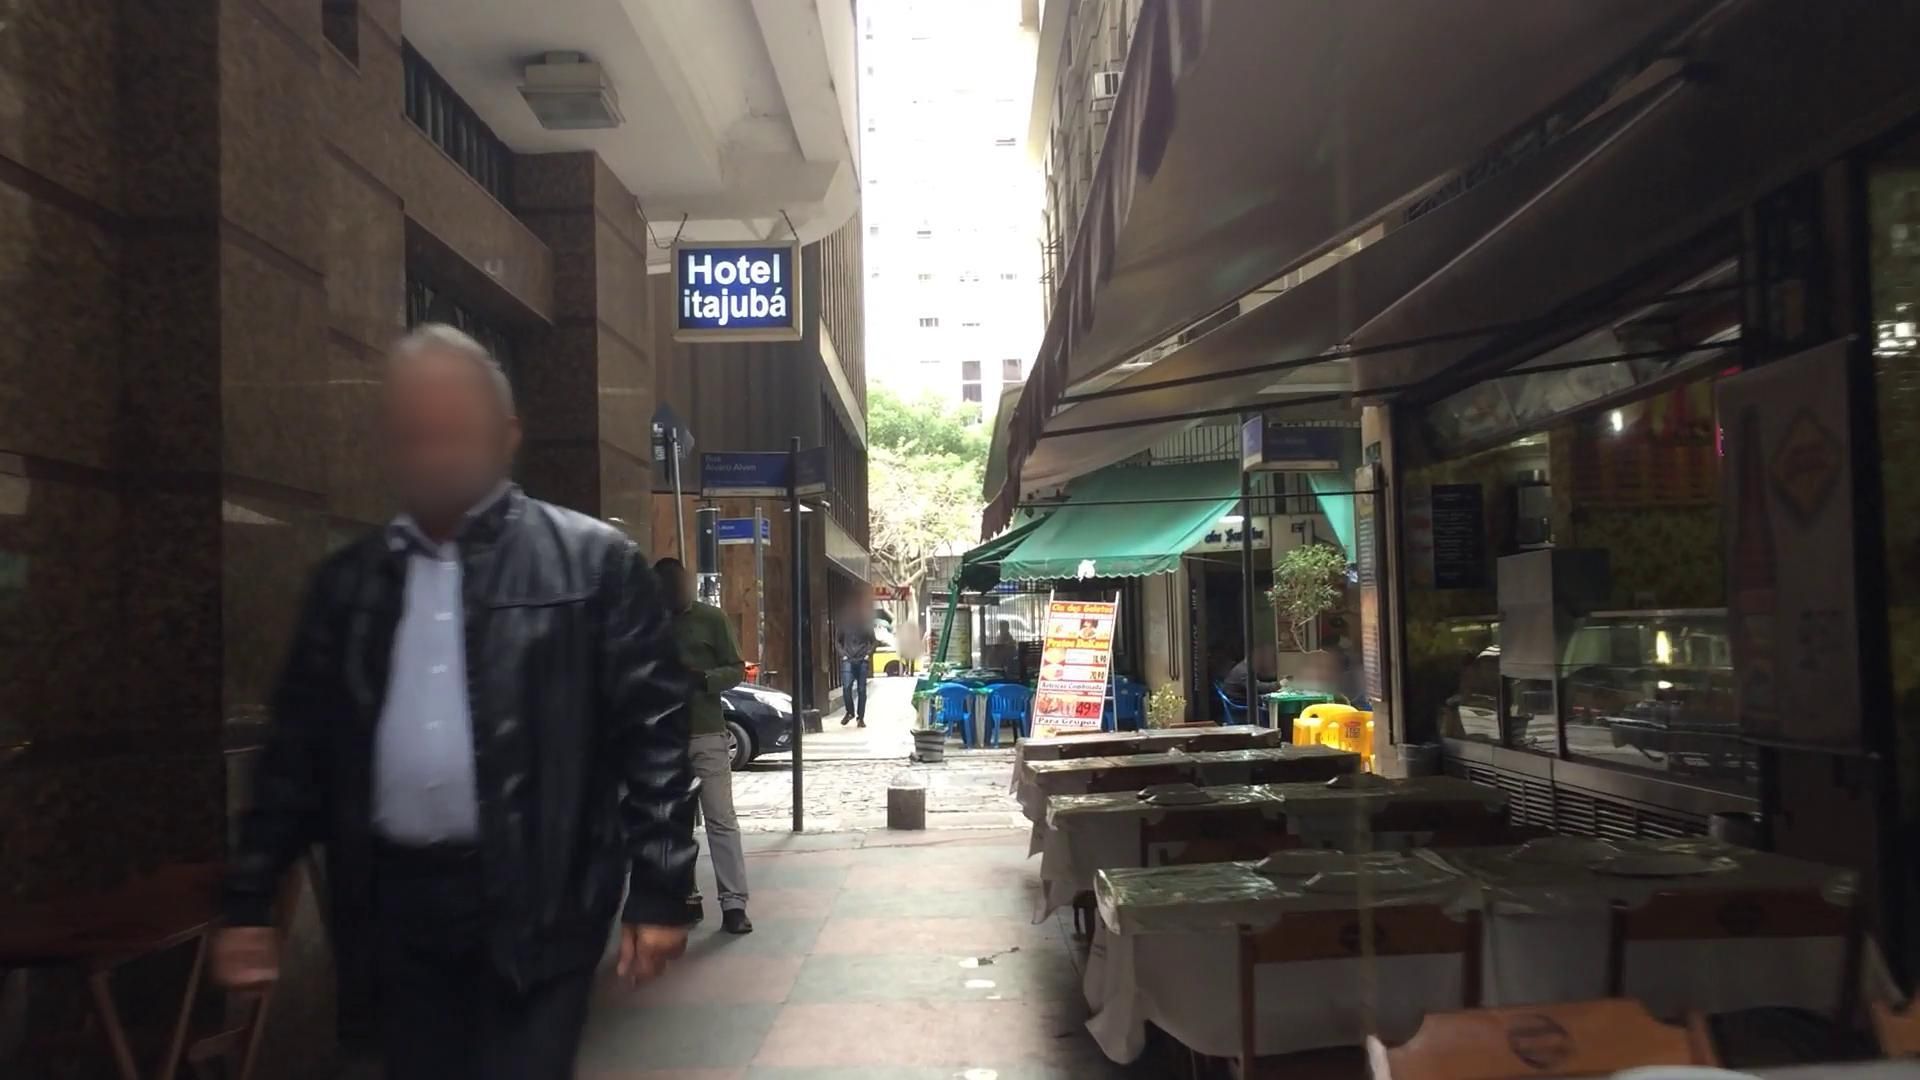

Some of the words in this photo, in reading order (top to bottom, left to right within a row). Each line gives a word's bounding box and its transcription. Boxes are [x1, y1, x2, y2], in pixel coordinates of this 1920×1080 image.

[687, 253, 780, 285] Hotel
[684, 286, 786, 326] itajubá
[1062, 718, 1096, 727] Grupos
